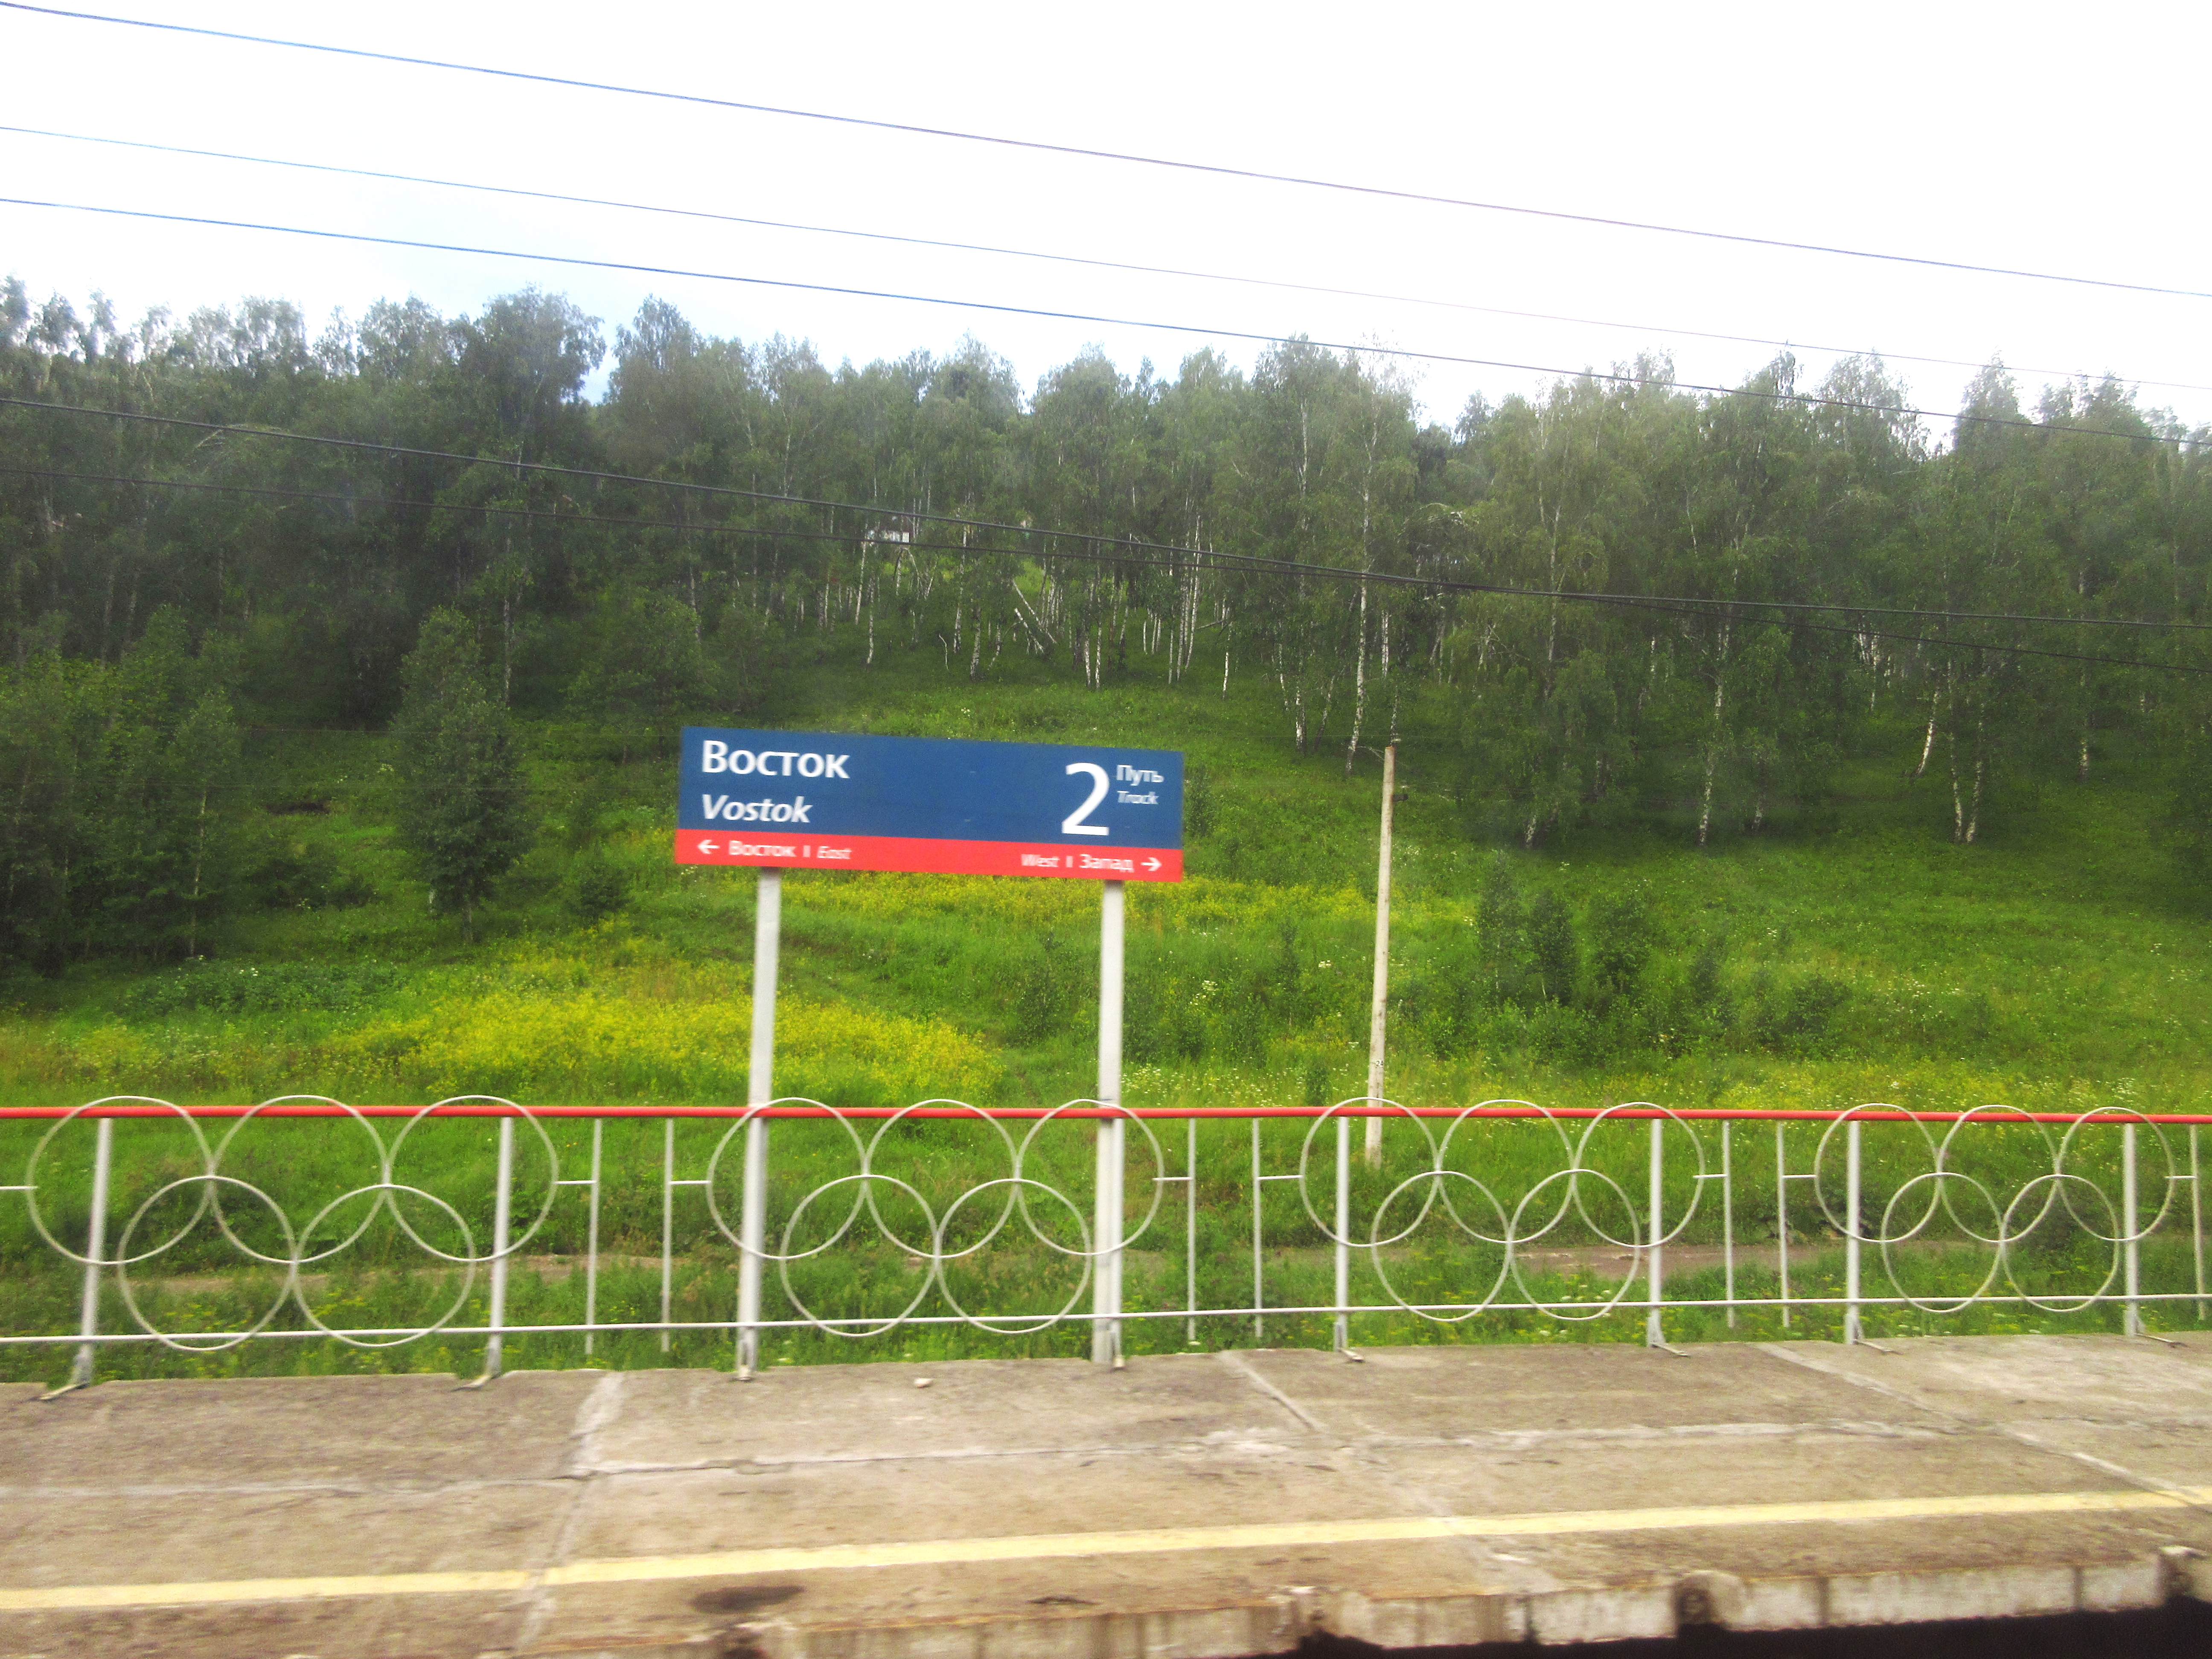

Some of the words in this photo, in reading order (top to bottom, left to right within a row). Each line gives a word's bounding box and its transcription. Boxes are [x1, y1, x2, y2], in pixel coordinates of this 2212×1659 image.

[702, 740, 850, 778] Восток
[1116, 764, 1164, 786] Путь
[702, 794, 812, 823] Vostok
[1062, 762, 1109, 836] 2
[1117, 790, 1159, 805] Track
[728, 840, 796, 857] Восток
[817, 846, 852, 859] East
[1021, 853, 1060, 867] West
[1079, 854, 1135, 873] Запад
